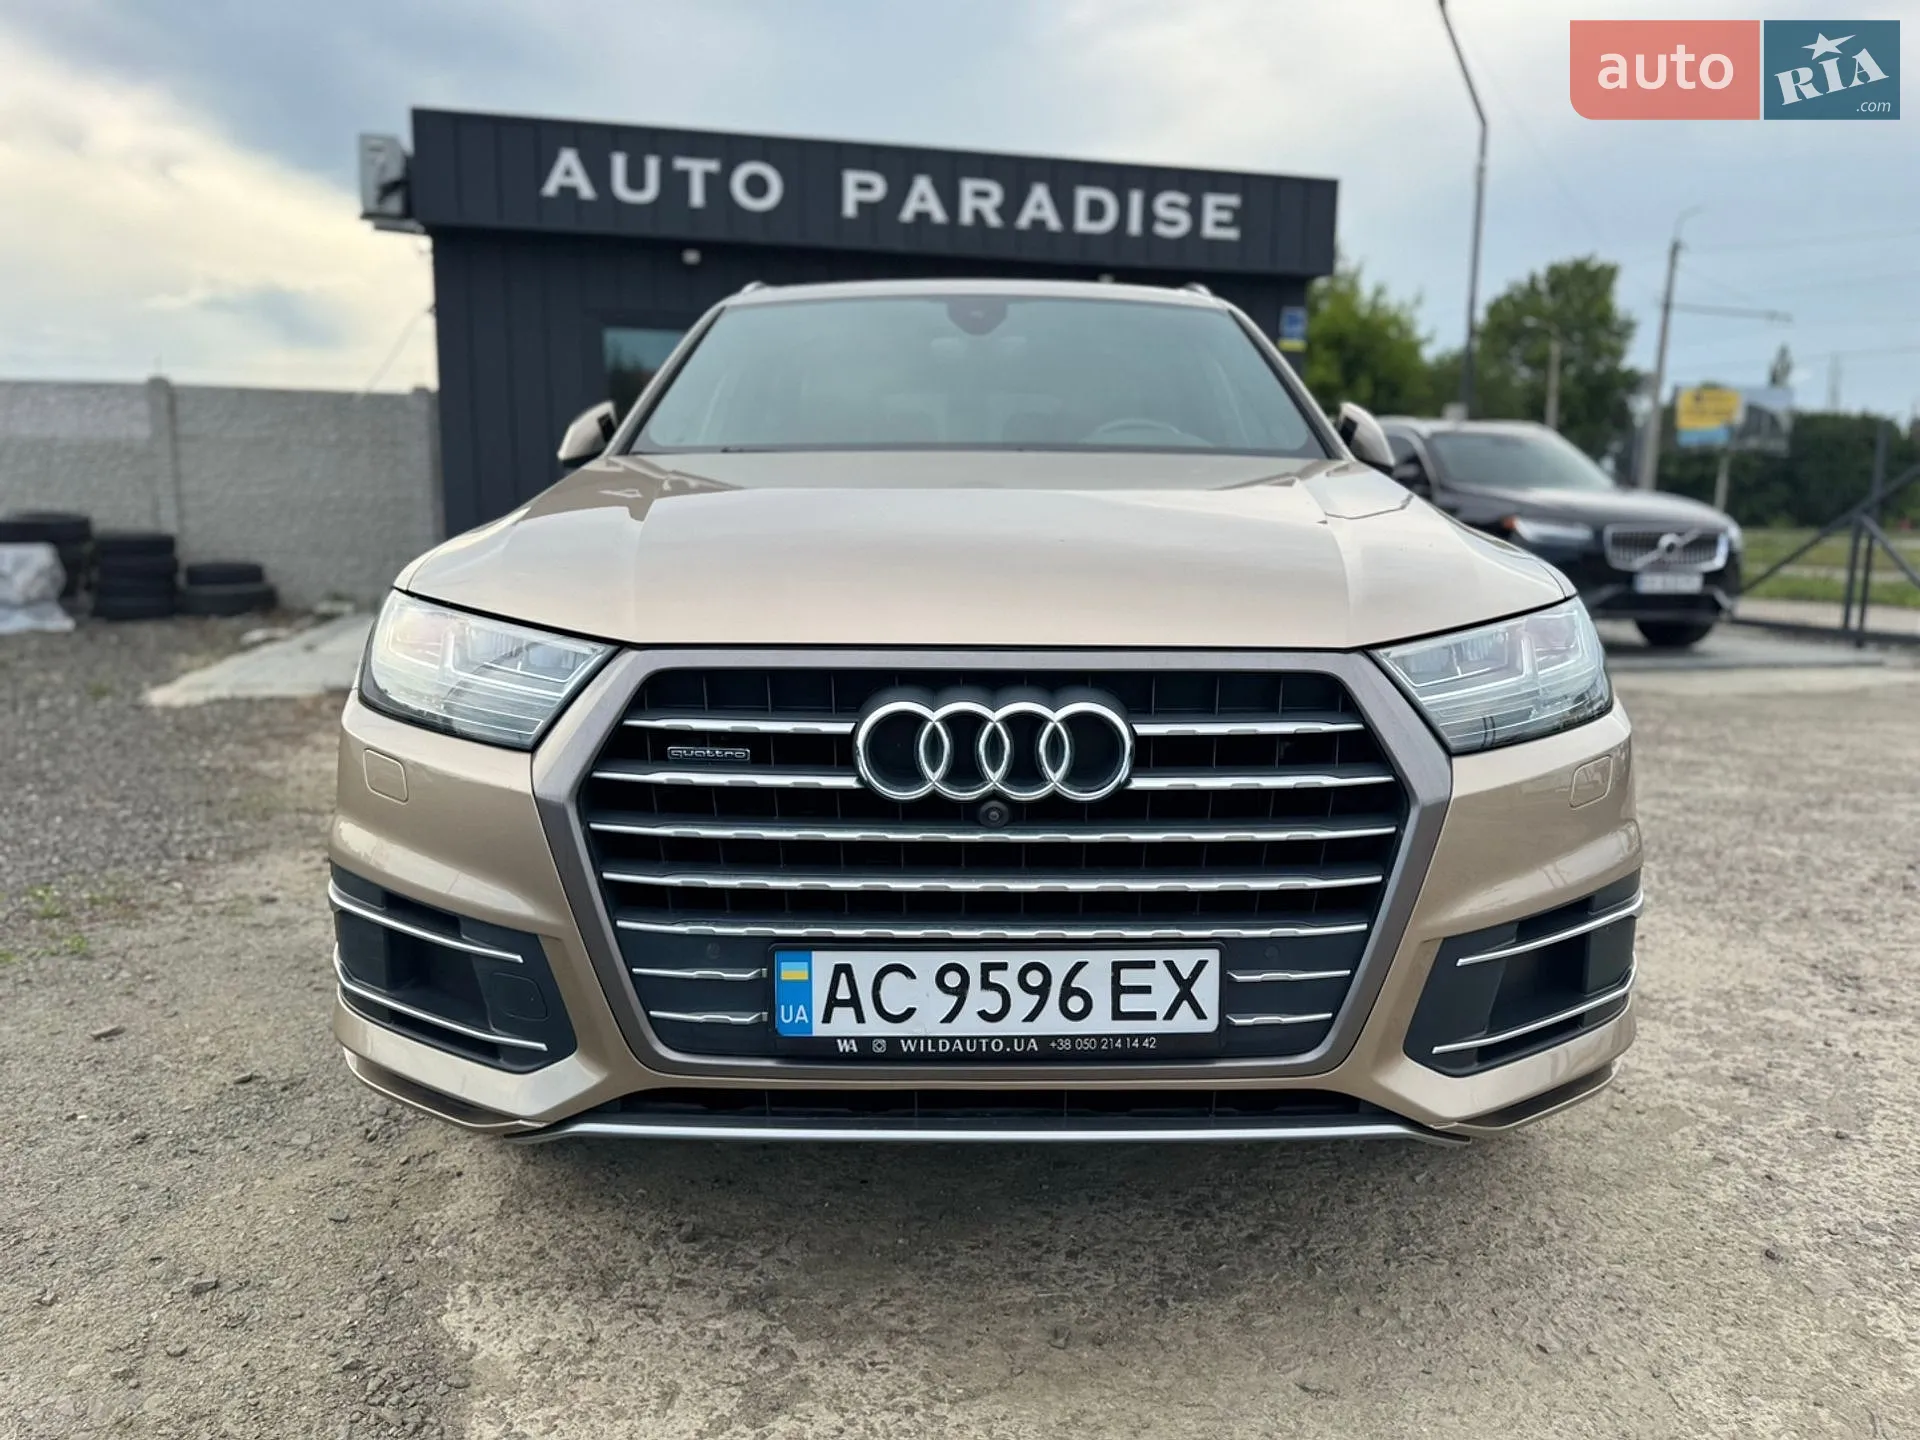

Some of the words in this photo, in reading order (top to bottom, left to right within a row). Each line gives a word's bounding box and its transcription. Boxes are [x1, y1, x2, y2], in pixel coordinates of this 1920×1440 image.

[540, 147, 785, 213] AUTO
[840, 168, 1242, 241] PARADISE
[670, 749, 746, 759] quattro
[821, 962, 917, 1025] AC
[934, 960, 1094, 1023] 9596
[1110, 958, 1210, 1022] EX
[780, 1006, 809, 1024] UA
[900, 1037, 1039, 1053] WILDAUTO.UA
[1050, 1038, 1071, 1051] +38
[1075, 1038, 1097, 1050] 050
[1101, 1037, 1122, 1050] 214
[1126, 1037, 1139, 1049] 14
[1142, 1036, 1157, 1049] 42
